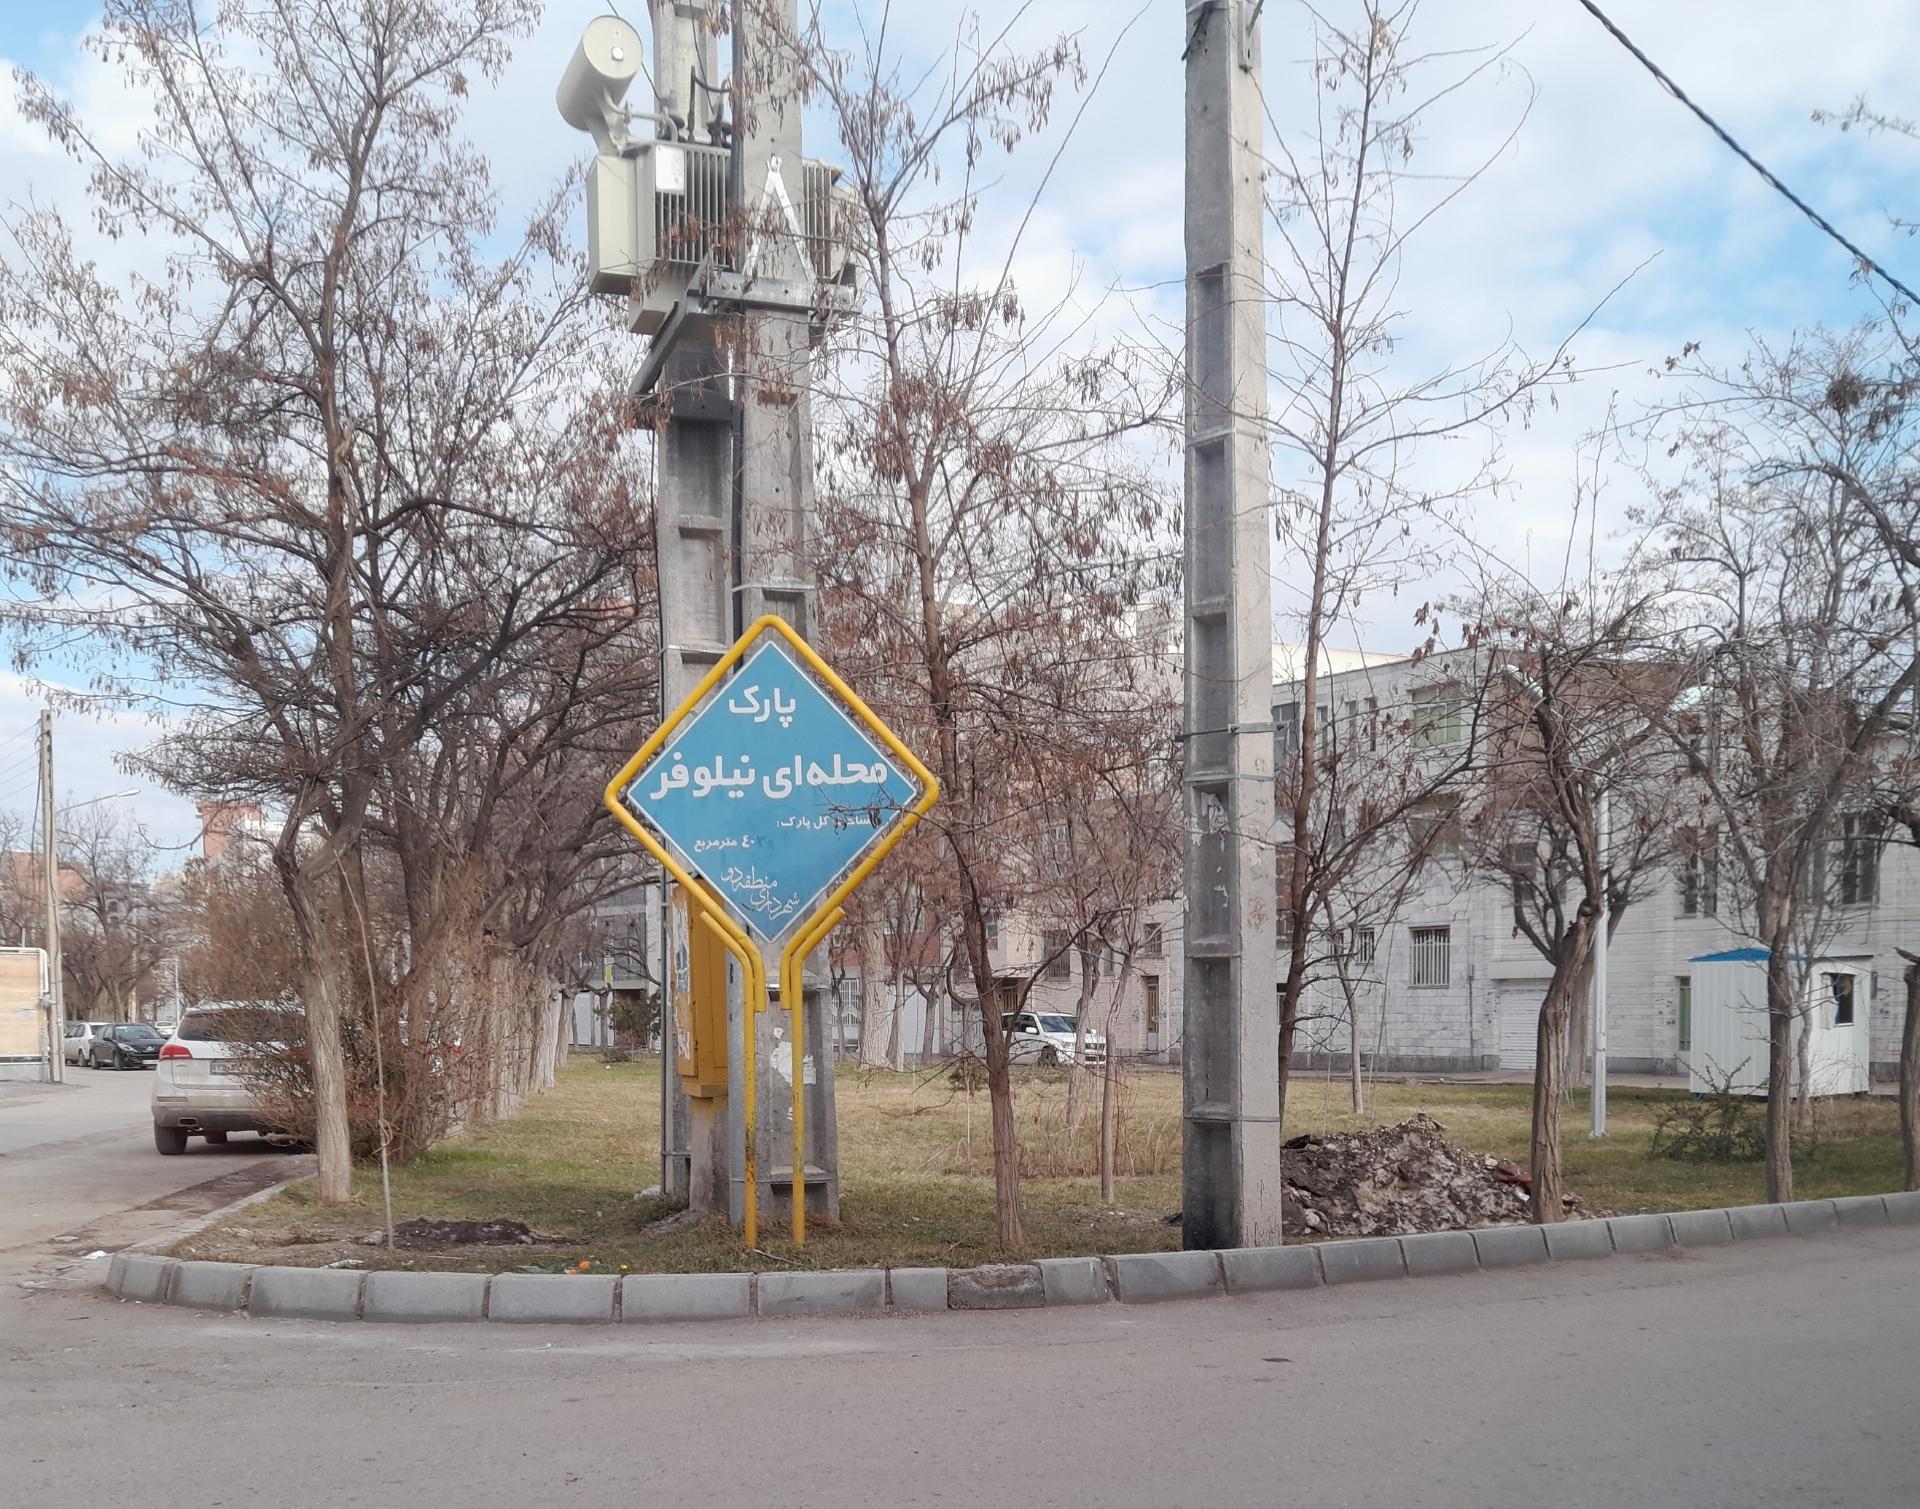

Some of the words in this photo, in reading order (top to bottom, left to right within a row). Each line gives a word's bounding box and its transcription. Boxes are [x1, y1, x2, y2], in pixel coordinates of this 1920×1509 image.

[728, 685, 797, 728] پارک
[649, 751, 756, 800] نیلوفر
[813, 815, 830, 830] کل
[720, 866, 744, 884] دو
[731, 865, 778, 892] منطقه
[750, 887, 800, 921] شهرداری
